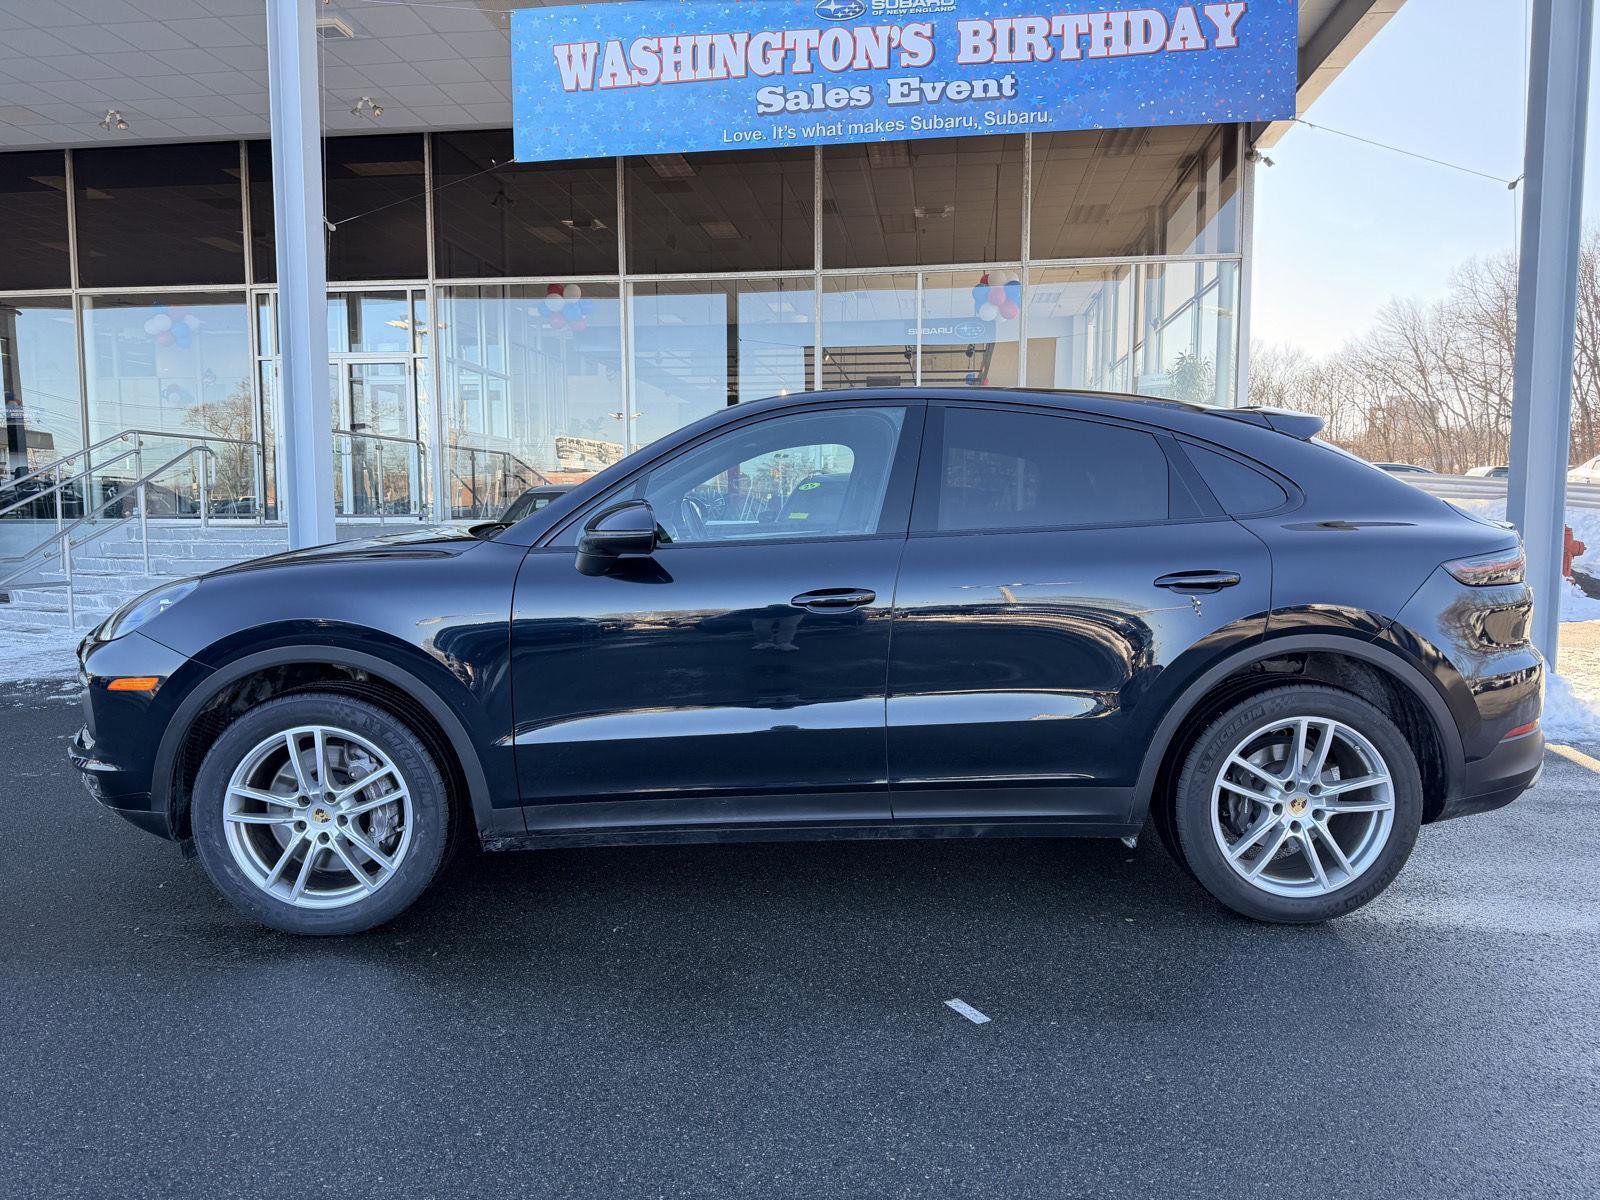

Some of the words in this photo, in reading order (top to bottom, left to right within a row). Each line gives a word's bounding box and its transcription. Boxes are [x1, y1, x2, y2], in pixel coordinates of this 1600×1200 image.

[910, 6, 955, 14] ENGLAND
[553, 23, 934, 92] WASHINGTON'S
[957, 3, 1247, 65] BIRTHDAY
[756, 83, 872, 116] Sales
[886, 73, 1018, 106] Event
[723, 128, 767, 143] Love.
[773, 124, 797, 140] It's
[802, 121, 843, 137] what
[848, 118, 905, 134] makes
[910, 113, 979, 131] Subaru,
[984, 108, 1053, 127] Subaru.
[1208, 706, 1264, 757] MICHELIN
